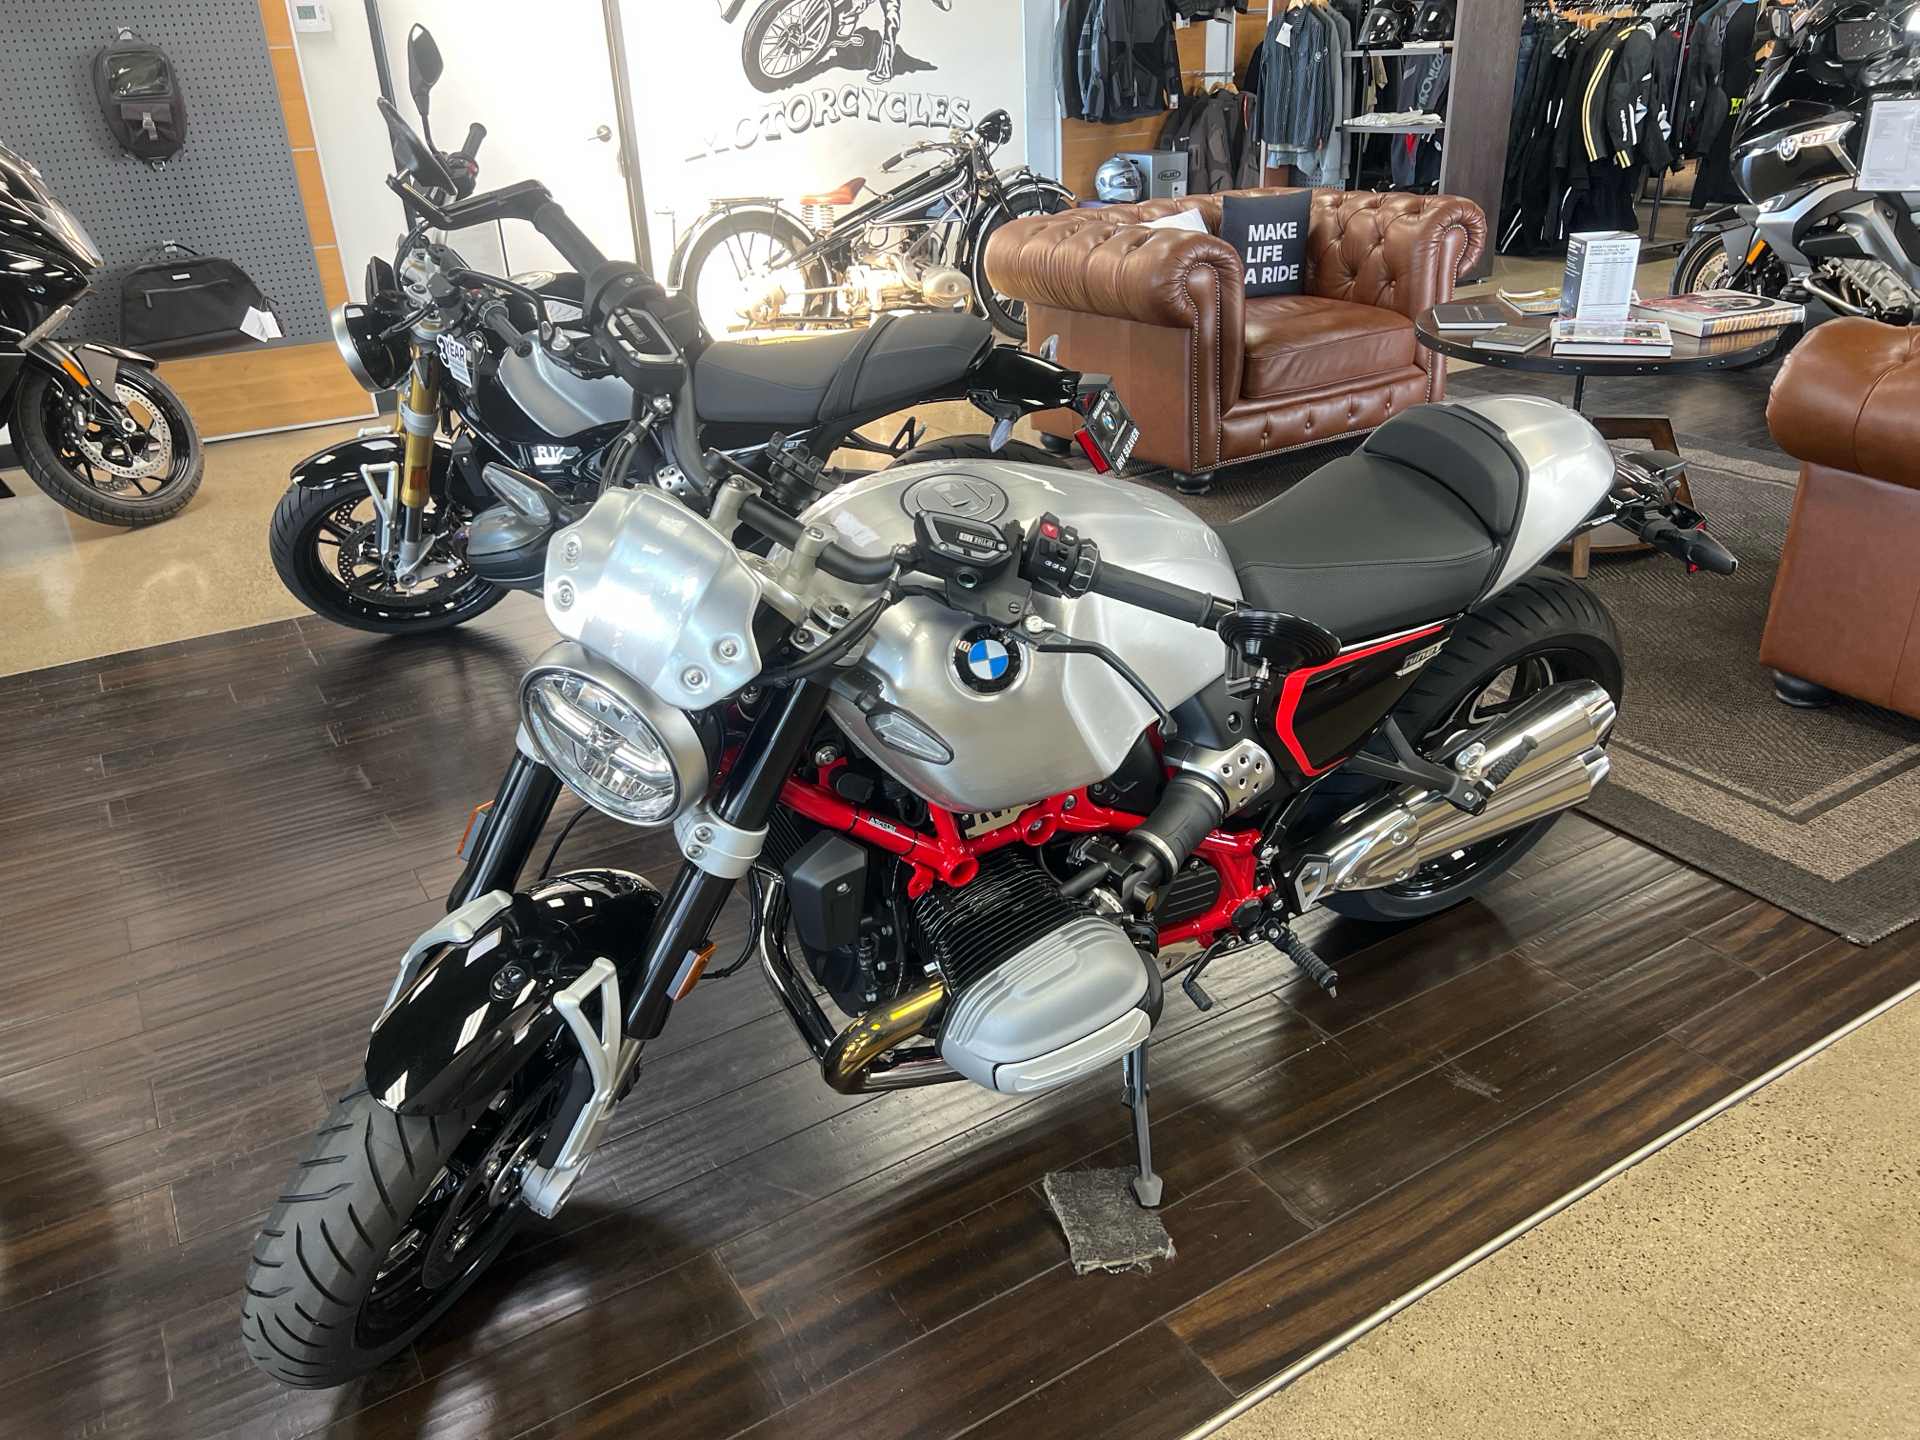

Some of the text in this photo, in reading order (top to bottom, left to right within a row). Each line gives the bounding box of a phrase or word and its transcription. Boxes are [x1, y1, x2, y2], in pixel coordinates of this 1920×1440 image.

[1248, 222, 1297, 242] MAKE
[1247, 245, 1283, 263] LIFE
[1244, 264, 1299, 284] A RIDE
[1712, 308, 1794, 333] MOTORCYCLE
[438, 336, 465, 365] 3 YEAR
[1115, 453, 1126, 471] IRV
[1122, 427, 1140, 458] SEAVER
[1403, 637, 1450, 669] nineT
